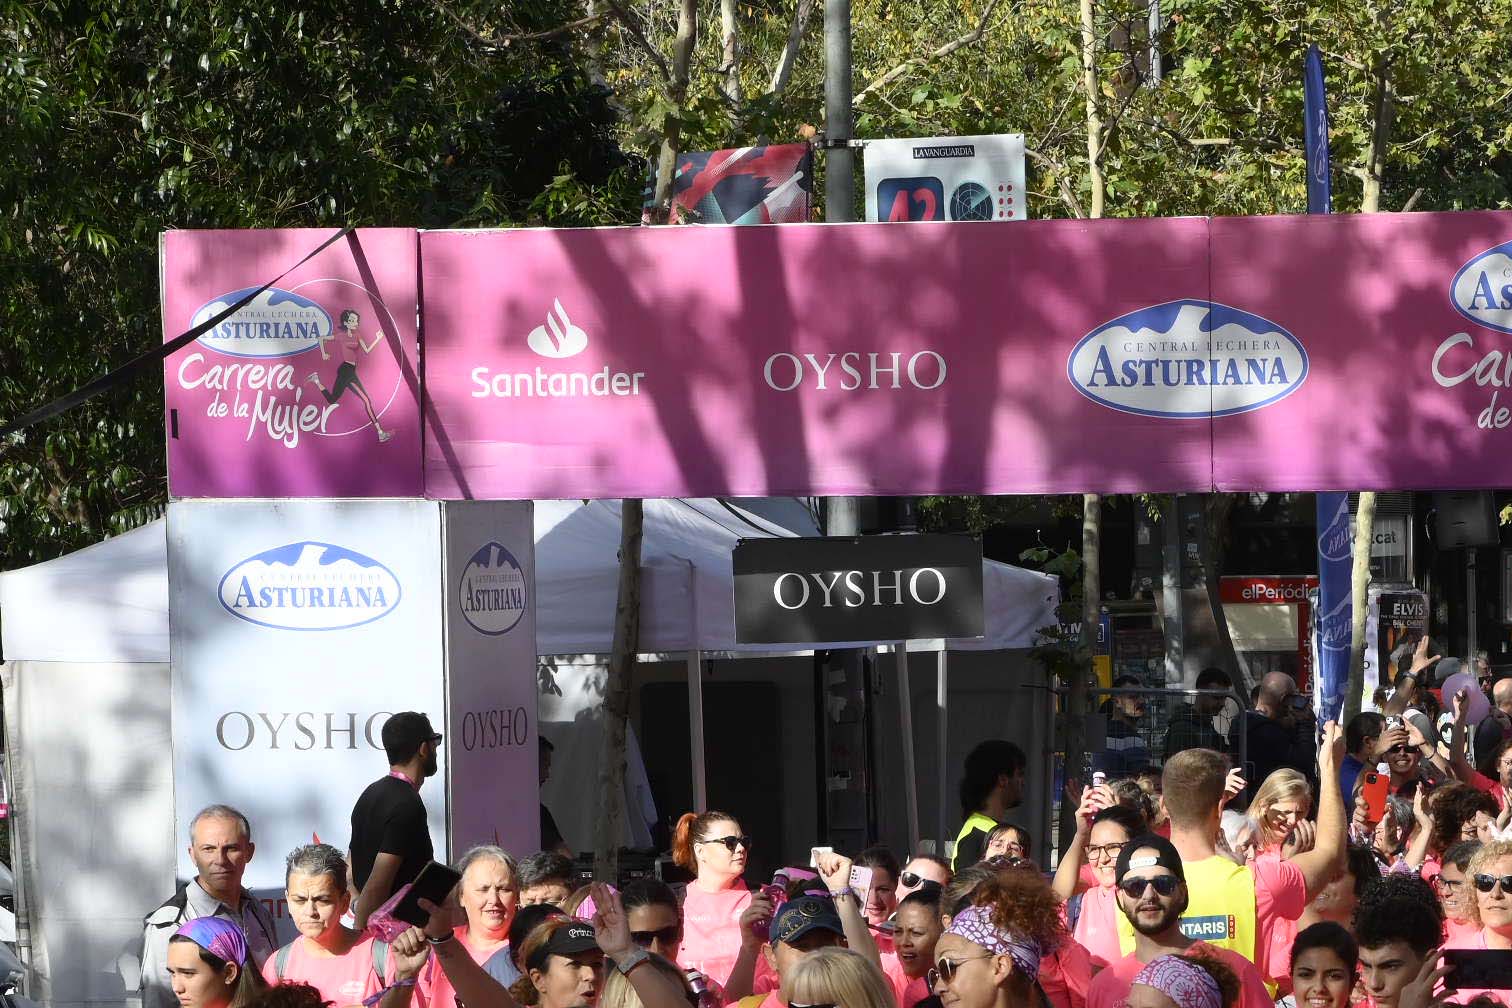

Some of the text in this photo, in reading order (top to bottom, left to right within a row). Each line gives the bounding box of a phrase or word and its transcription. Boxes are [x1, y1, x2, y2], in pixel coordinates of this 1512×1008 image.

[1124, 339, 1281, 352] CENTRAL LECHERA
[177, 352, 294, 390] Carrera
[471, 366, 646, 398] Santander
[763, 350, 948, 392] OYSHO
[1086, 345, 1289, 388] ASTURIANA
[207, 384, 339, 449] de la Mujer
[1477, 399, 1510, 429] de
[232, 575, 388, 609] ASTURIANA
[464, 577, 522, 613] ASTURIANA
[773, 567, 947, 610] OYSHO
[1393, 603, 1423, 615] ELVIS
[462, 706, 528, 751] OYSHO
